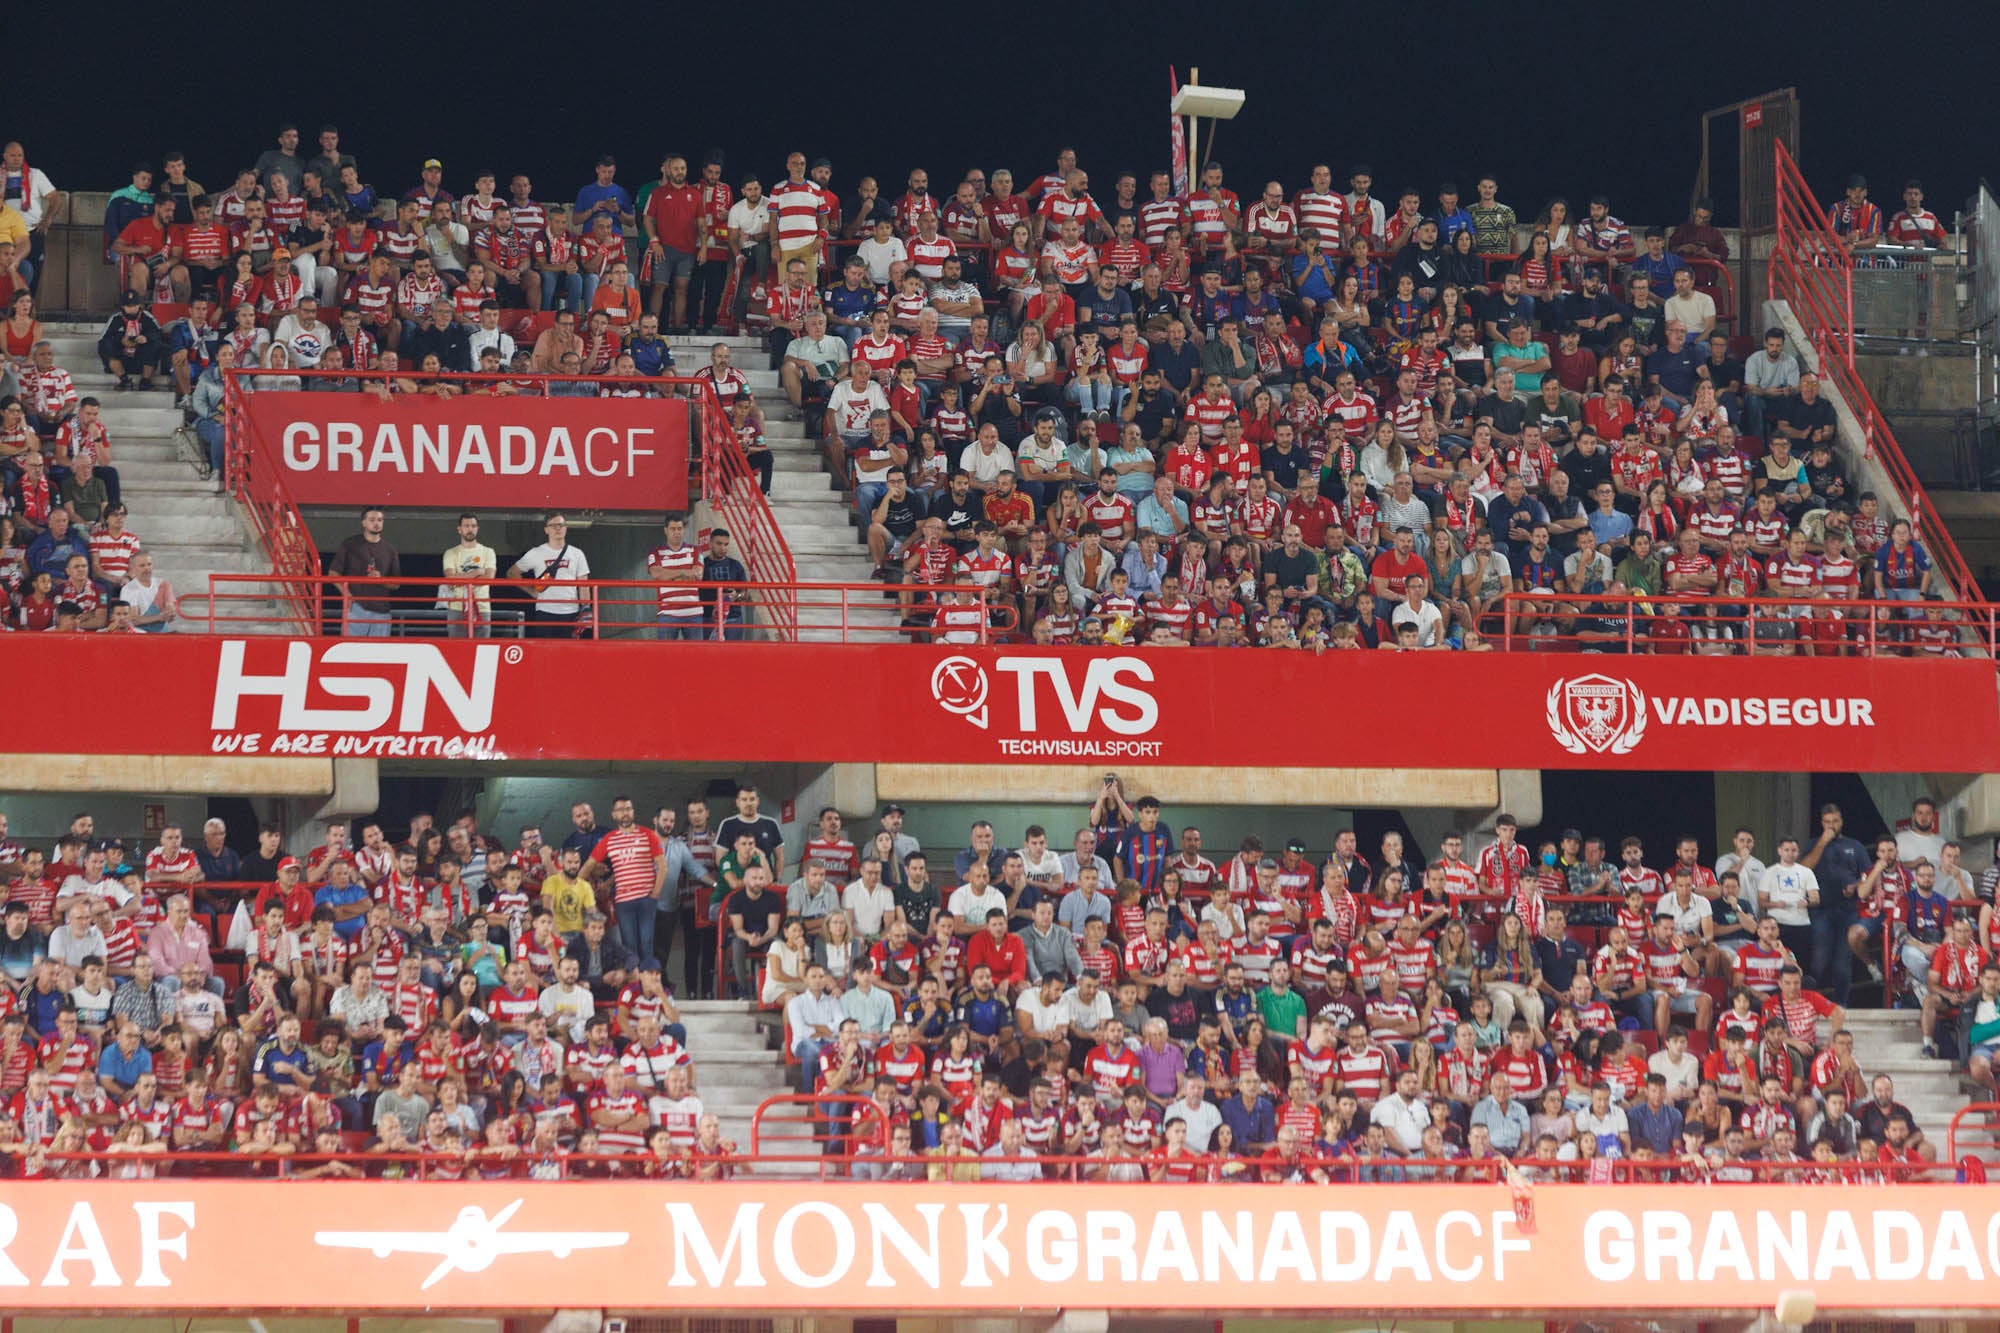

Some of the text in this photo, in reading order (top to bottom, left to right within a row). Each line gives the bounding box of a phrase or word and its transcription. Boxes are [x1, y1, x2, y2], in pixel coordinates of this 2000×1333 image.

[283, 421, 654, 477] GRANADACF
[211, 640, 500, 733] HSN
[996, 656, 1158, 735] TVS
[1571, 687, 1620, 695] VADISEGUR
[1651, 697, 1875, 726] VADISEGUR
[211, 733, 496, 756] WE ARE NUTRITION!
[998, 739, 1163, 757] TECHVISUALSPORT
[665, 1202, 1010, 1289] MONK
[1026, 1210, 1531, 1282] GRANADACF
[1583, 1210, 2000, 1282] GRANADA
